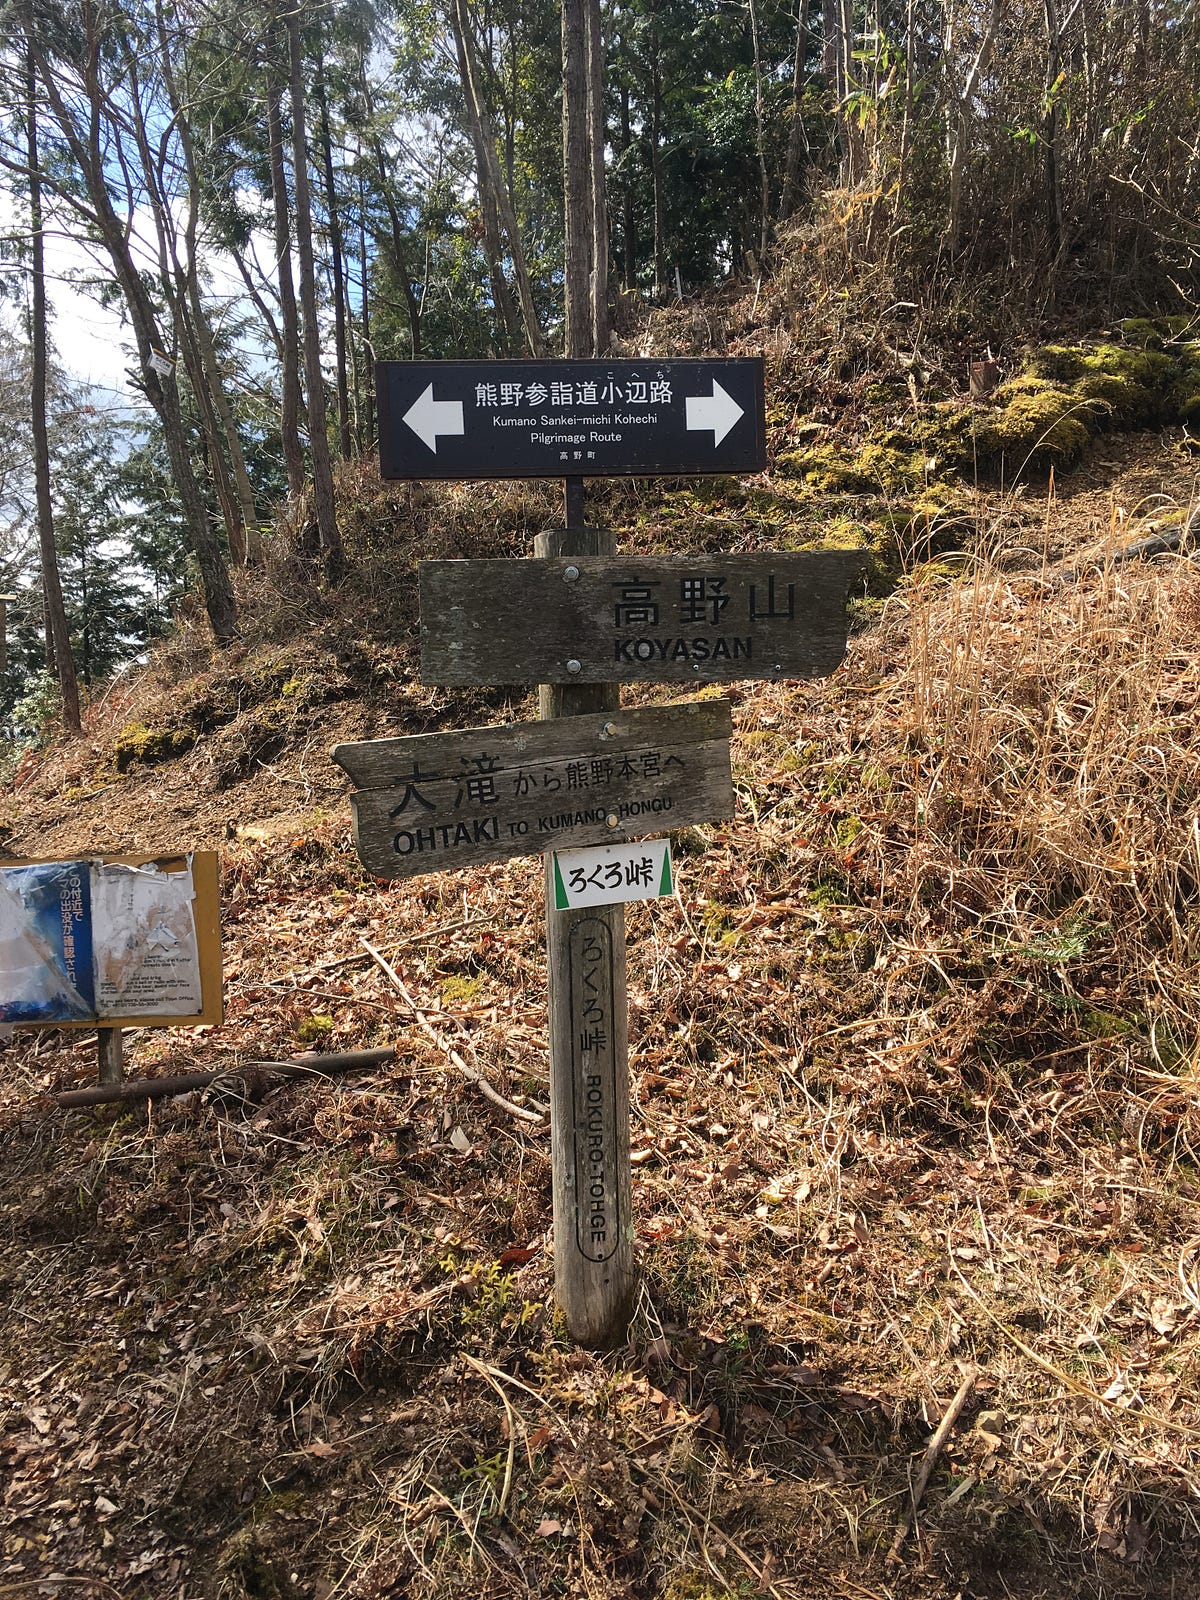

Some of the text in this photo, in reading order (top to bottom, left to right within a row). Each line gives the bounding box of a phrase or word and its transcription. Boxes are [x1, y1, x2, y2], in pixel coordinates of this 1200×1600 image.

[474, 381, 673, 407] 熊野参詣道小辺路
[493, 413, 657, 427] Kumano Sankei-michi Kohechi
[530, 432, 622, 445] Pilgrimage Route
[559, 451, 596, 460] 高野町
[612, 575, 795, 627] 高野山
[614, 637, 753, 661] KOYASAN
[393, 797, 673, 855] OHTAKI TO KUMANO HONGU
[568, 857, 654, 893] ろくろ峠
[58, 868, 77, 988] クマの出没が確認され
[580, 937, 607, 1055] ろくろ峠
[586, 1075, 606, 1243] ROKURO-TOHGE
